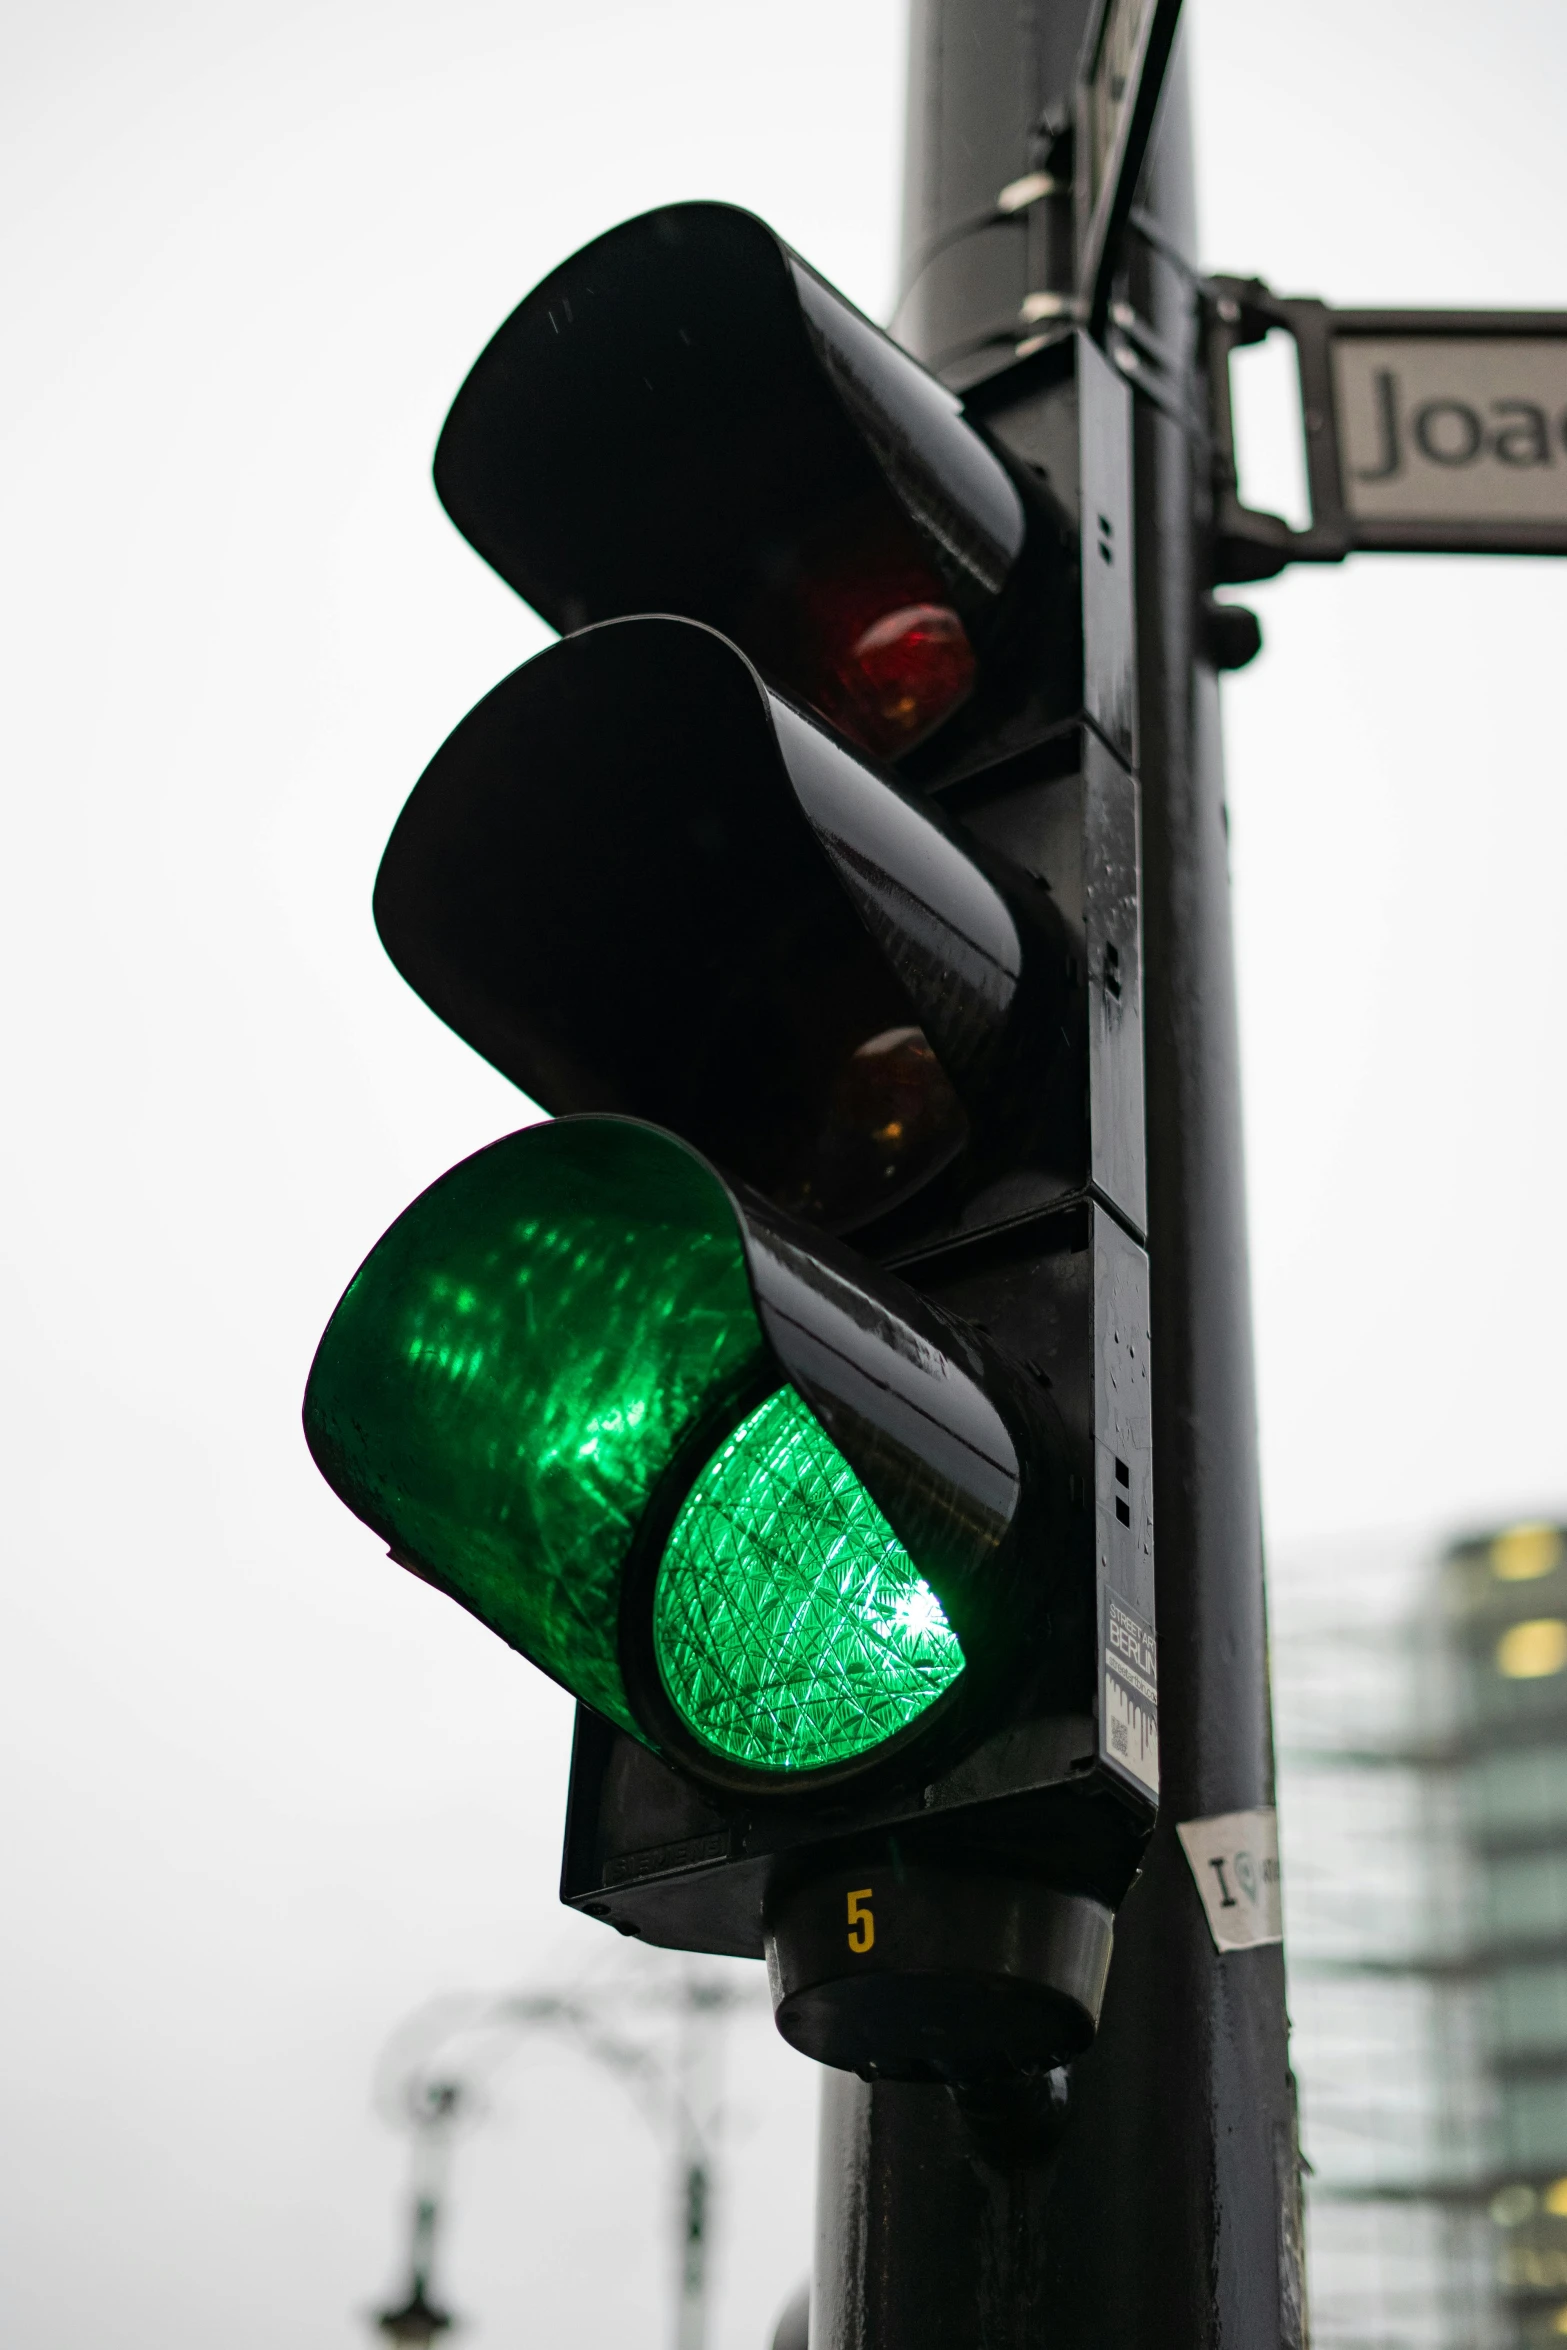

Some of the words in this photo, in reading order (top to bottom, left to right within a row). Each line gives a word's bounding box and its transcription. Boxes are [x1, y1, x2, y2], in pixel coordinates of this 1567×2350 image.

[1356, 368, 1567, 482] Joa
[1109, 1603, 1142, 1638] STREET
[1109, 1619, 1157, 1679] BERLIN
[612, 1836, 722, 1879] SIEMENS
[1209, 1857, 1236, 1907] I
[847, 1888, 874, 1953] 5
